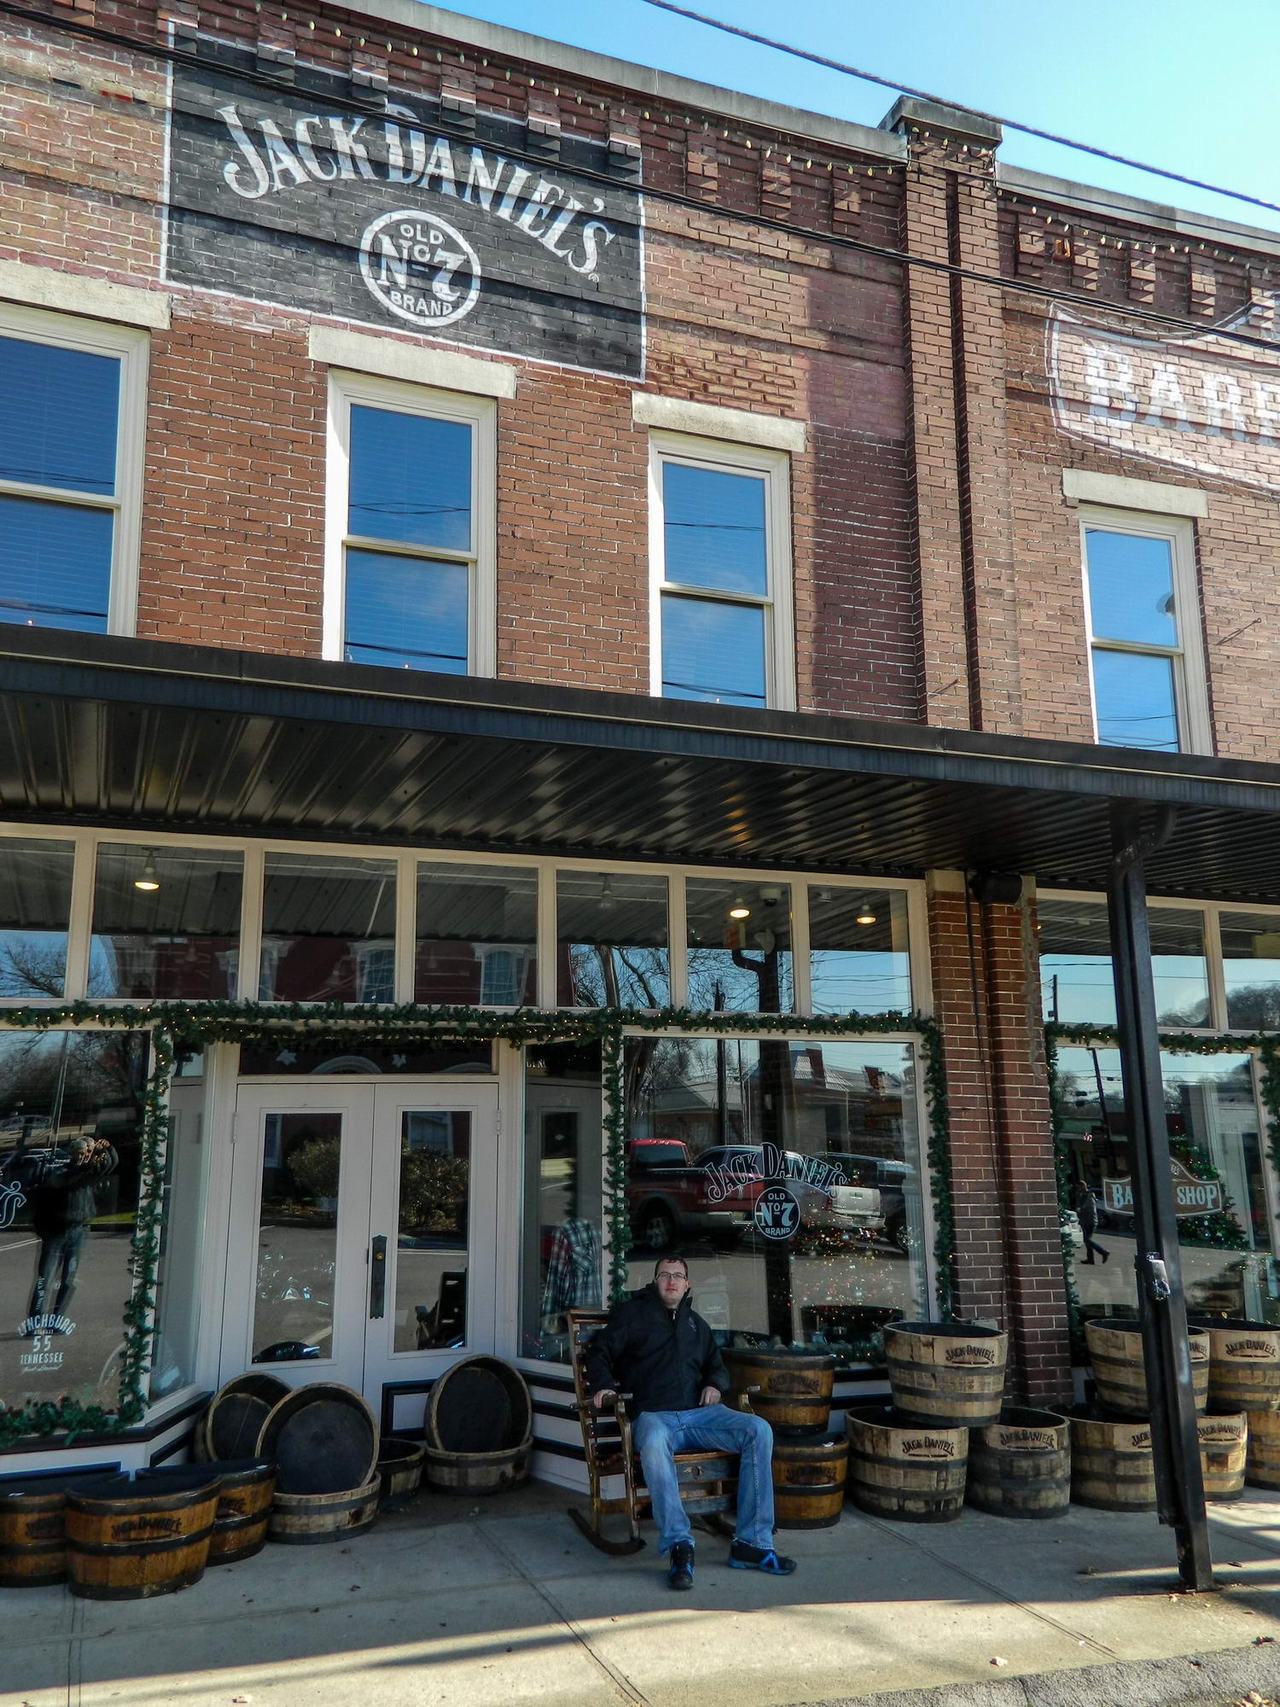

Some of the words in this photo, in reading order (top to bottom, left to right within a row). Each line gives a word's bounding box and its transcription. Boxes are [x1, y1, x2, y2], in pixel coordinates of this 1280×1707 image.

[216, 104, 379, 199] JACK
[384, 98, 616, 273] DANIEL'S
[400, 224, 445, 245] OLD
[390, 290, 453, 316] BRAND
[705, 1152, 764, 1203] JACK
[760, 1142, 848, 1200] DANIEL'S
[767, 1192, 786, 1201] OLD
[1176, 1184, 1217, 1209] SHOP
[765, 1227, 791, 1236] BRAND
[17, 1313, 77, 1337] LYNCHBURG
[32, 1335, 53, 1352] 55
[20, 1352, 64, 1365] TENNESSEE
[945, 1348, 964, 1361] JACK
[966, 1345, 995, 1364] DANIEL'S
[902, 1440, 921, 1454] JACK
[924, 1436, 955, 1456] DANIEL'S
